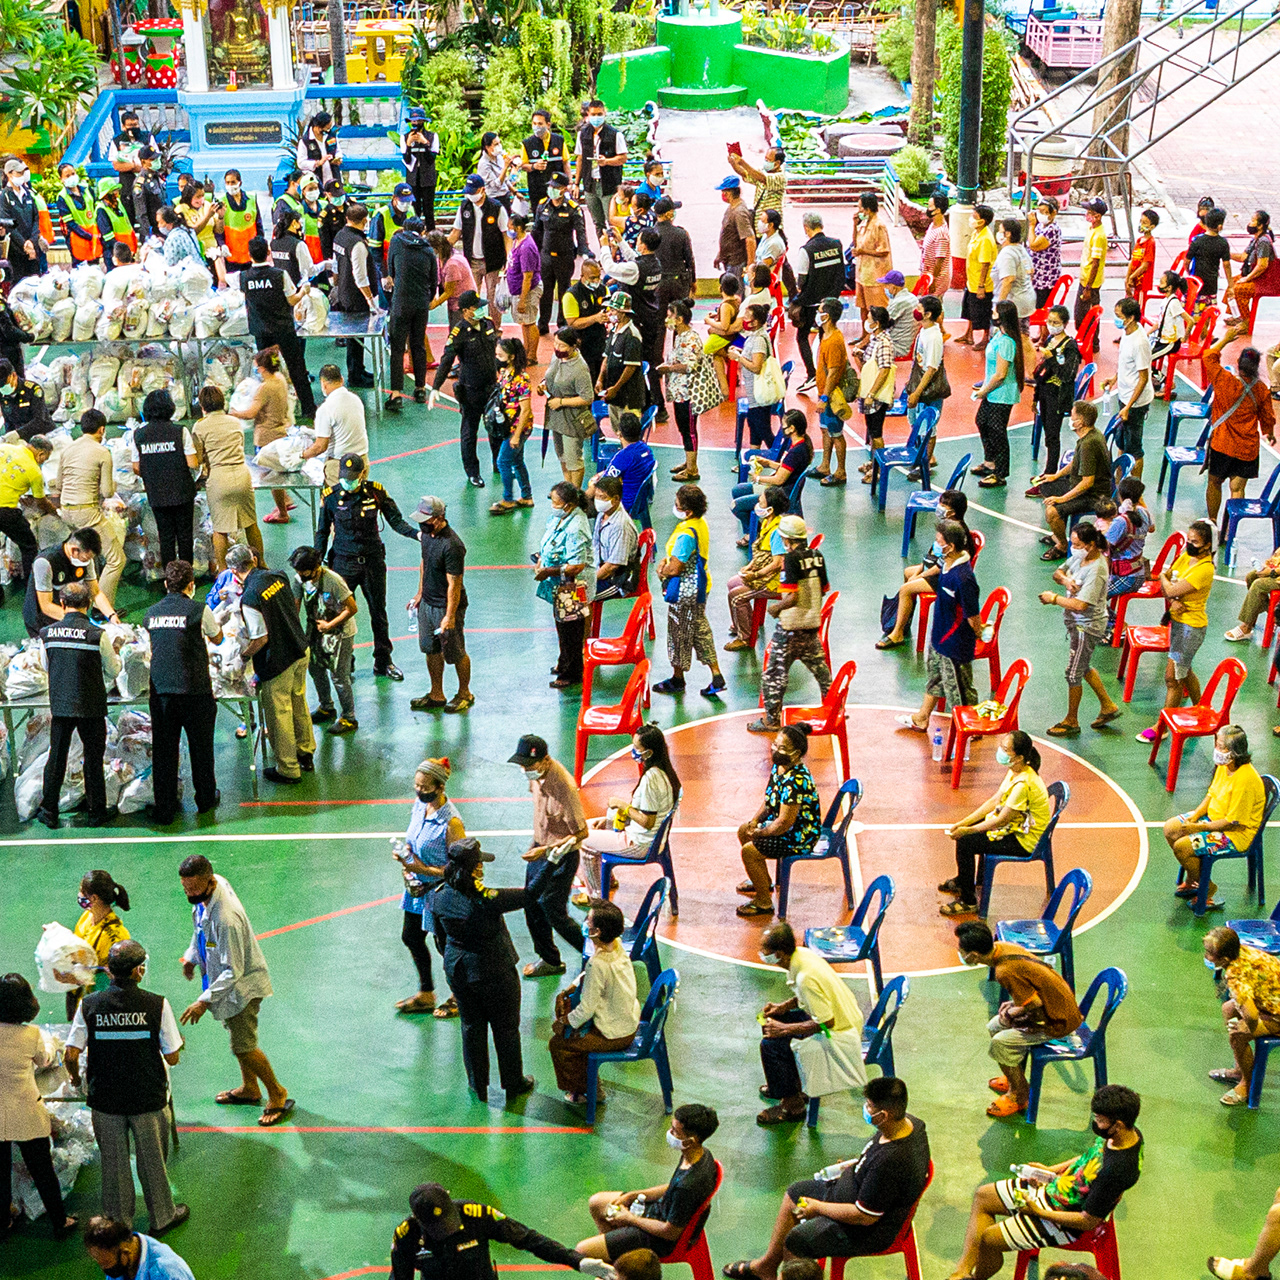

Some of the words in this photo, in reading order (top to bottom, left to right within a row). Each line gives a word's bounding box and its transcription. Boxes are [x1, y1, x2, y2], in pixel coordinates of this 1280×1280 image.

[248, 279, 273, 290] BMA
[141, 441, 176, 455] BANGKOK
[148, 615, 187, 629] BANGKOK
[47, 627, 86, 639] BANGKOK
[95, 1012, 148, 1027] BANGKOK
